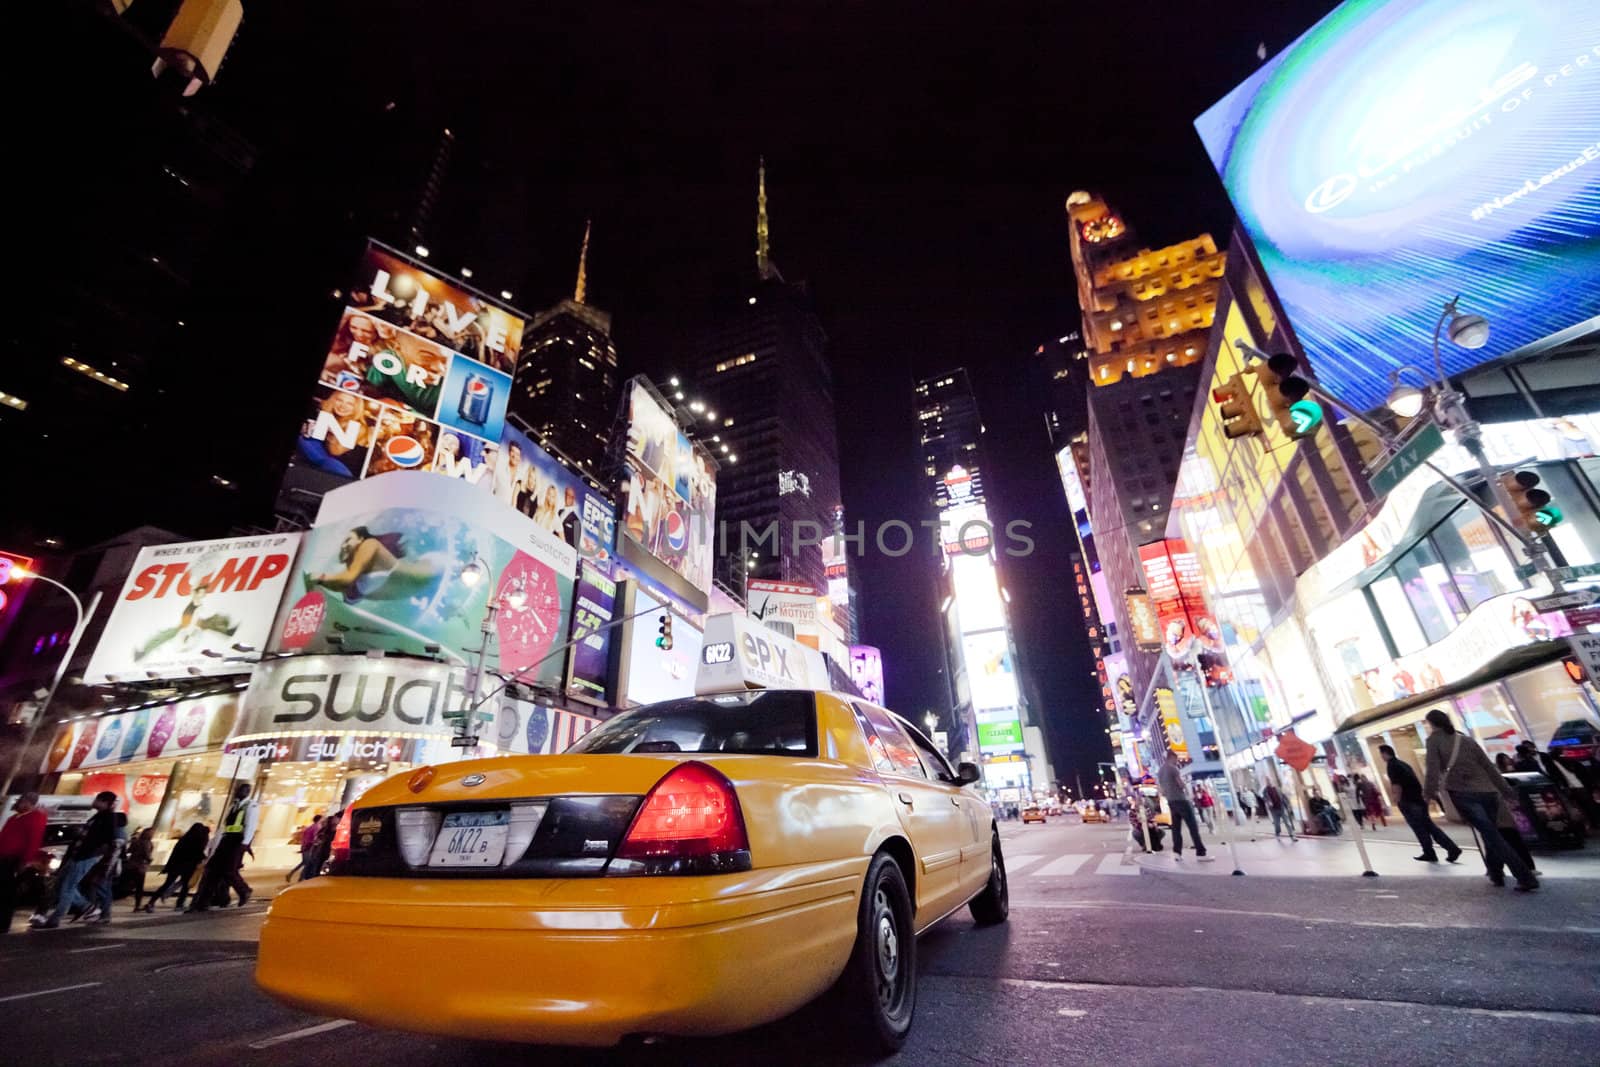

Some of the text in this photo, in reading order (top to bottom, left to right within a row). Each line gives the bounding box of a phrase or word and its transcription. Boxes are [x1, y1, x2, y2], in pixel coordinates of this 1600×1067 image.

[1502, 87, 1533, 112] OF
[370, 269, 508, 353] LIVE
[347, 341, 430, 389] FOR
[583, 501, 614, 534] EPIC
[154, 546, 182, 557] WHERE
[186, 545, 204, 555] NEW
[234, 540, 260, 550] TURNS
[263, 538, 273, 547] IT
[273, 537, 288, 546] UP
[125, 553, 290, 601] STOMP
[290, 603, 324, 623] PUSH
[780, 608, 815, 620] MOTIVO
[705, 643, 732, 663] 6K22
[1092, 647, 1116, 711] YOUNG
[308, 742, 387, 758] swatch
[447, 827, 483, 854] 6K22
